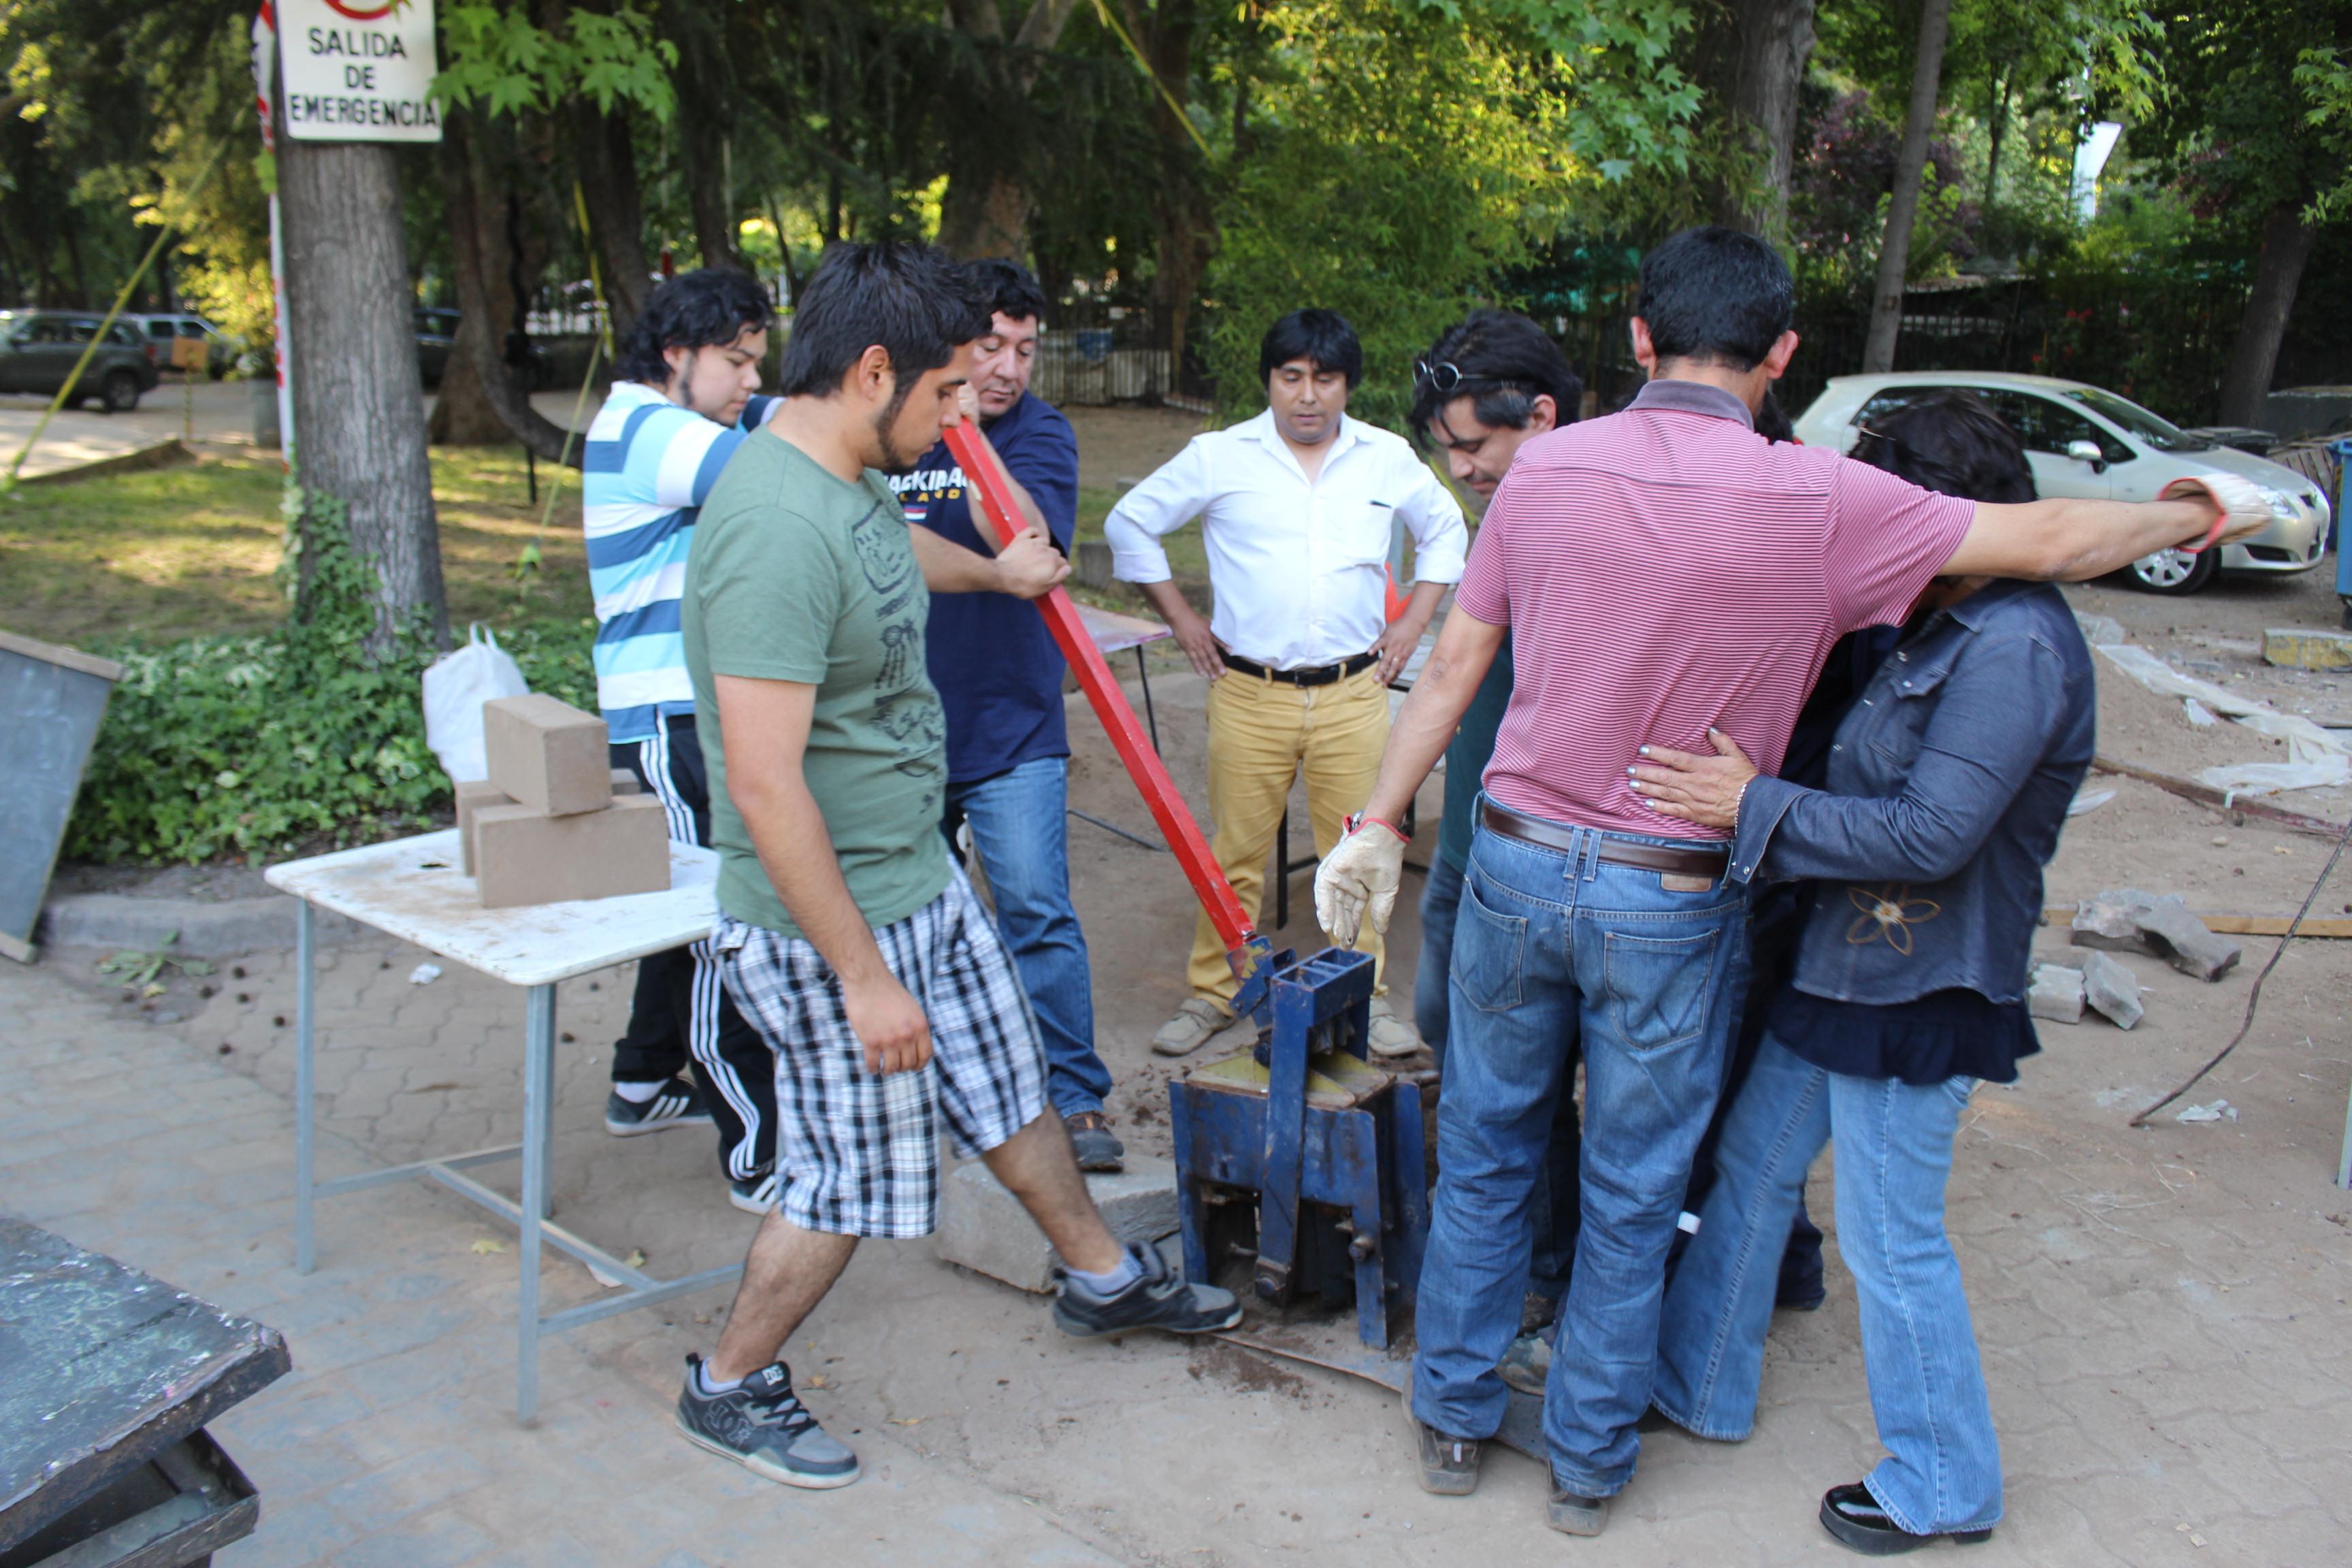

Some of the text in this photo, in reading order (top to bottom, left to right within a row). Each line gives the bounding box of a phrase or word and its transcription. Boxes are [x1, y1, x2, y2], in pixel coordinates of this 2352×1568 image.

[308, 27, 407, 59] SALIDA
[346, 65, 376, 89] DE
[291, 95, 440, 127] EMERGENCIA
